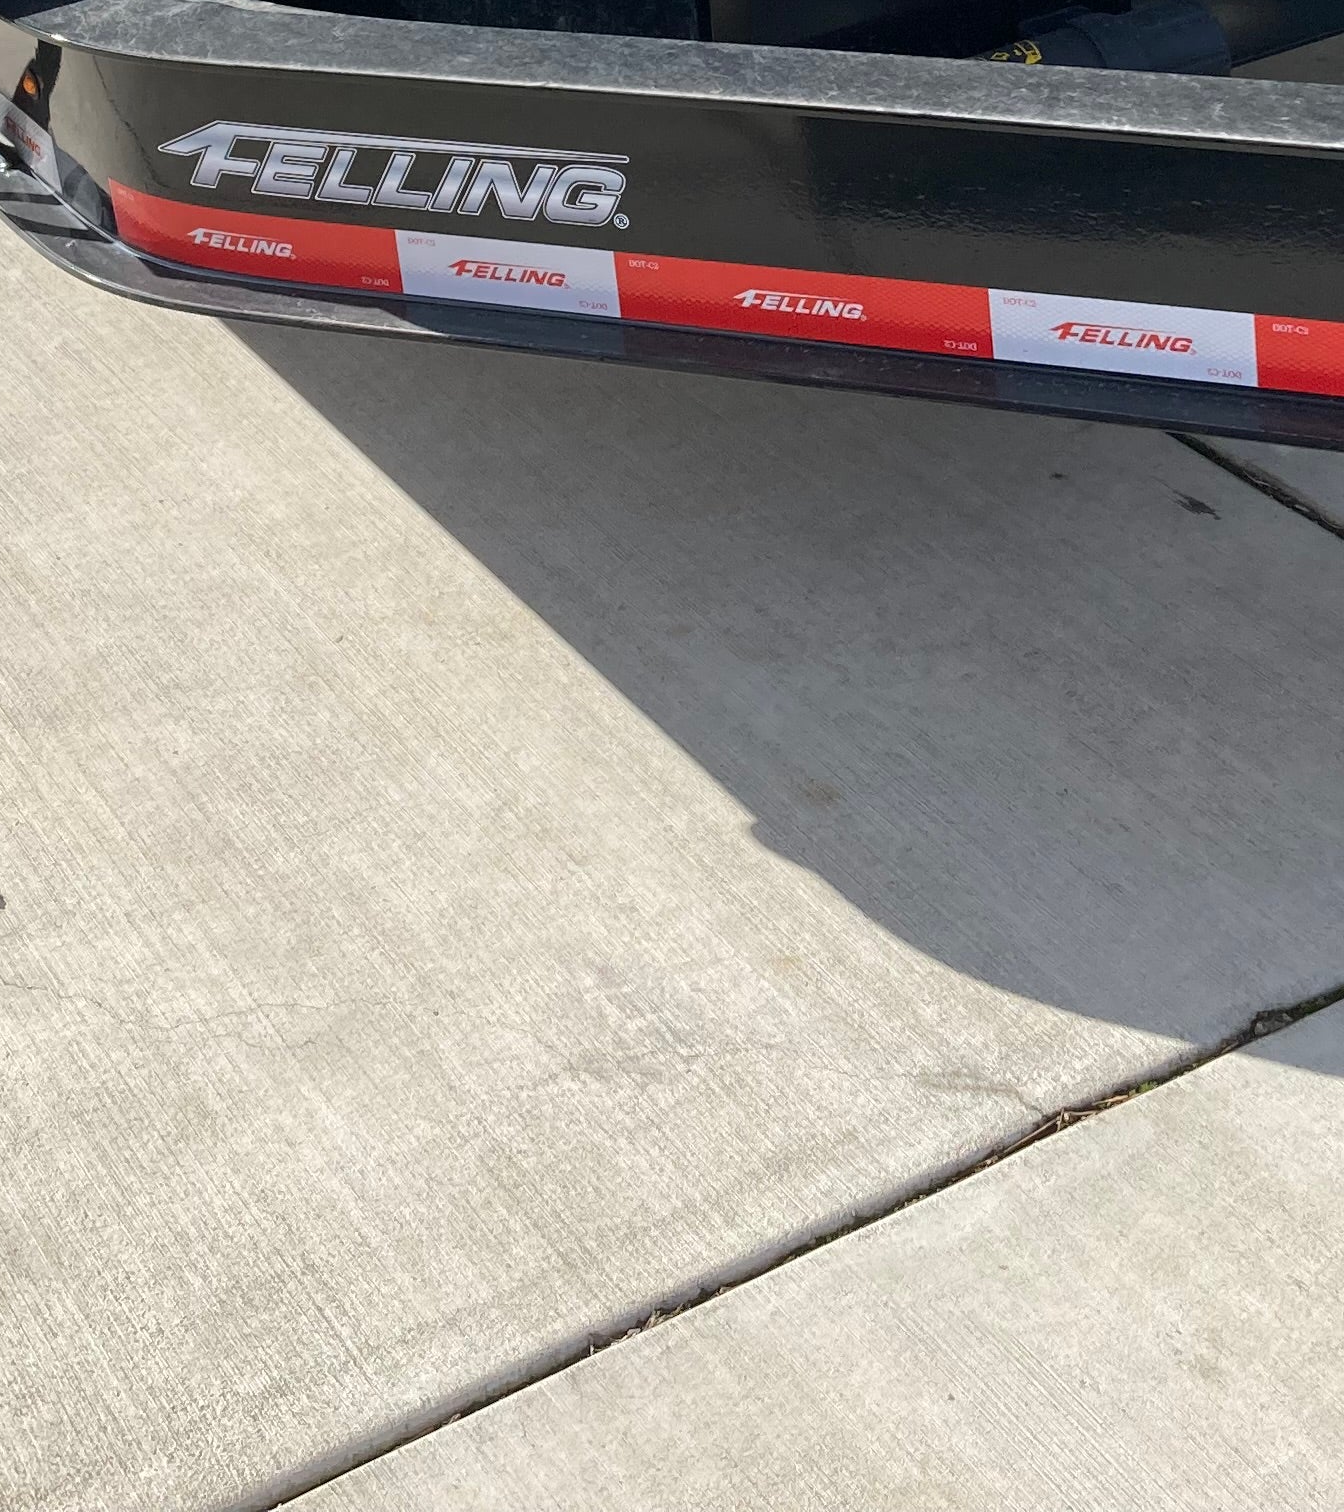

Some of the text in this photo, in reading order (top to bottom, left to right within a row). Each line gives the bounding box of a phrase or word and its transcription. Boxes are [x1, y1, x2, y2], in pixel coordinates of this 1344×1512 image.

[157, 119, 630, 228] FELLING
[187, 227, 296, 259] FELLING
[448, 259, 570, 288] FELLING
[733, 289, 867, 321] FELLING
[1049, 322, 1197, 355] FELLING
